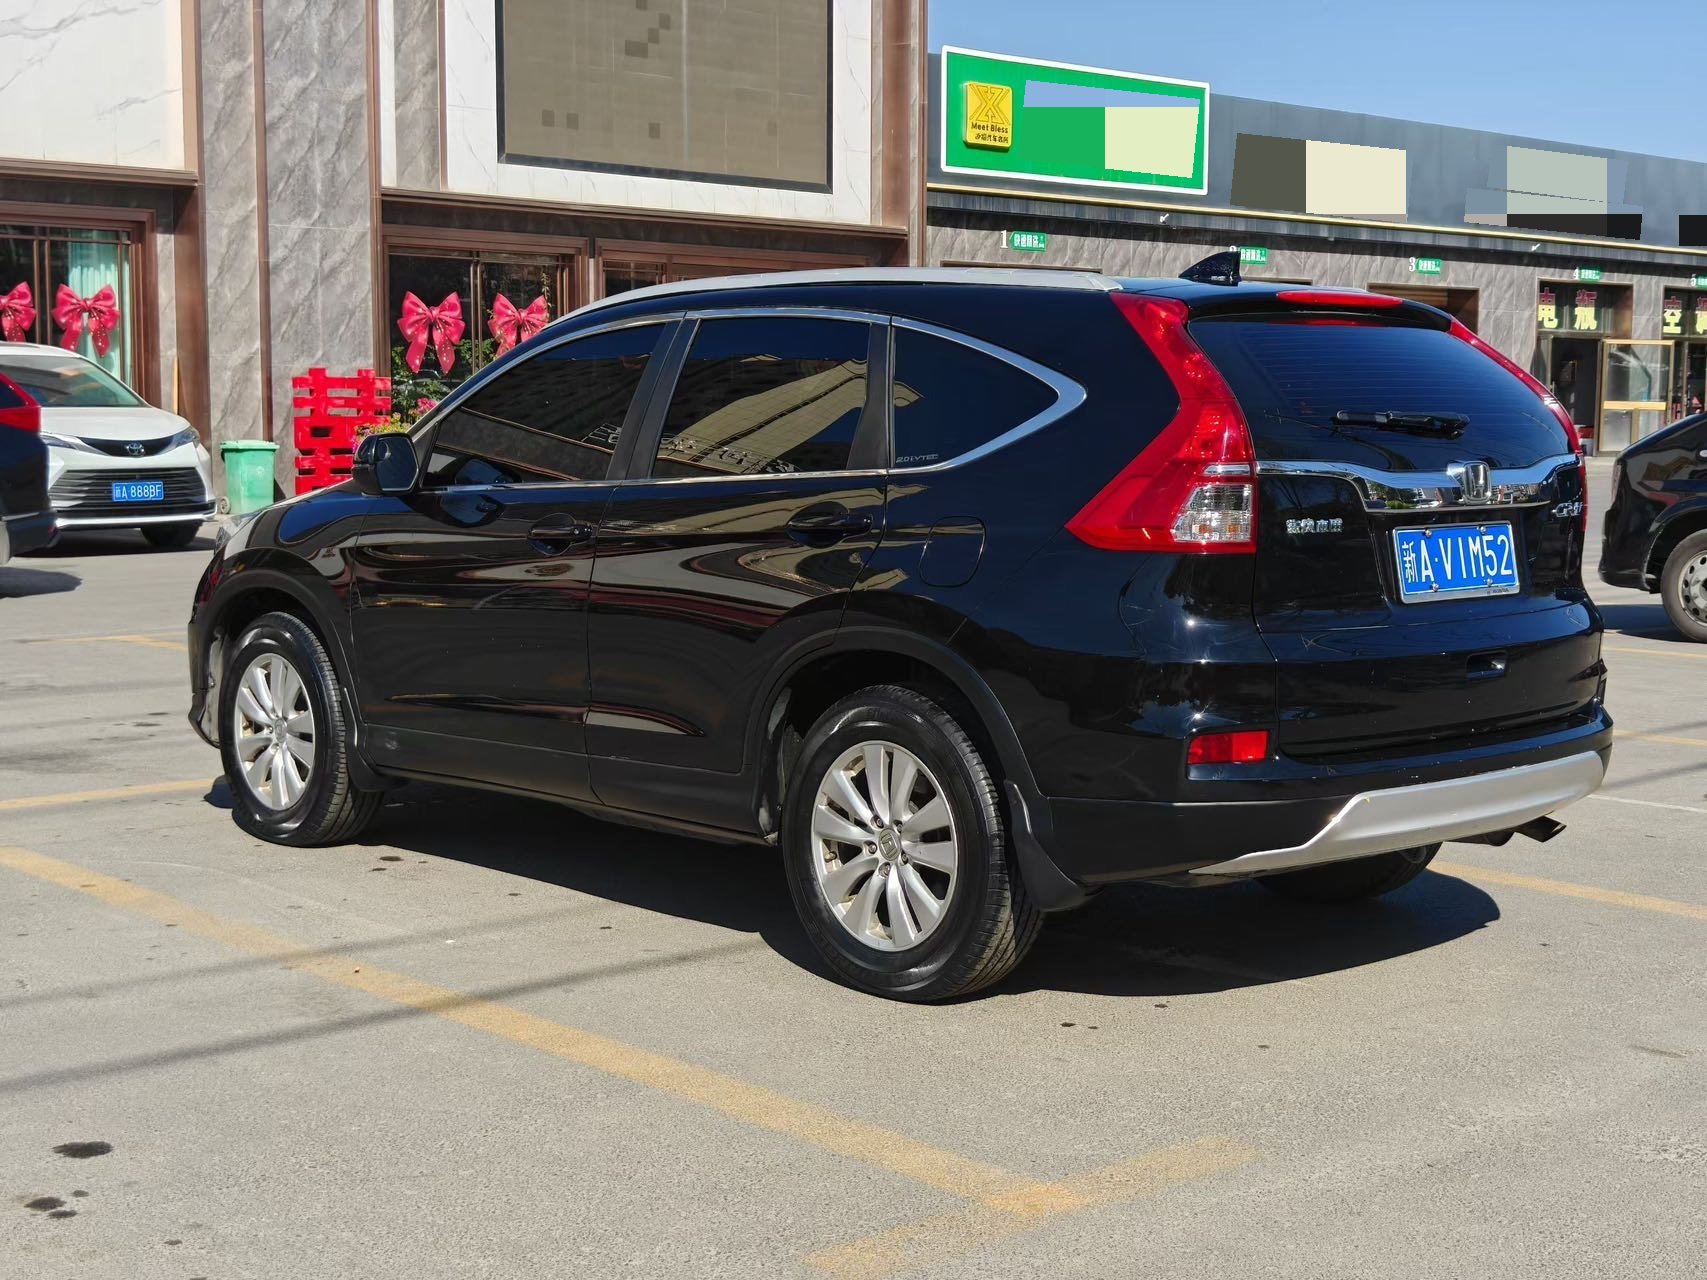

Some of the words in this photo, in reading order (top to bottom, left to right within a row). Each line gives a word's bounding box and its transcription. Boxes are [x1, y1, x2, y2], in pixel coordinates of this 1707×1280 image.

[971, 122, 989, 131] Meet
[990, 124, 1009, 134] Bless
[1000, 230, 1009, 249] 1
[1409, 257, 1416, 272] 3
[1573, 267, 1579, 280] 4
